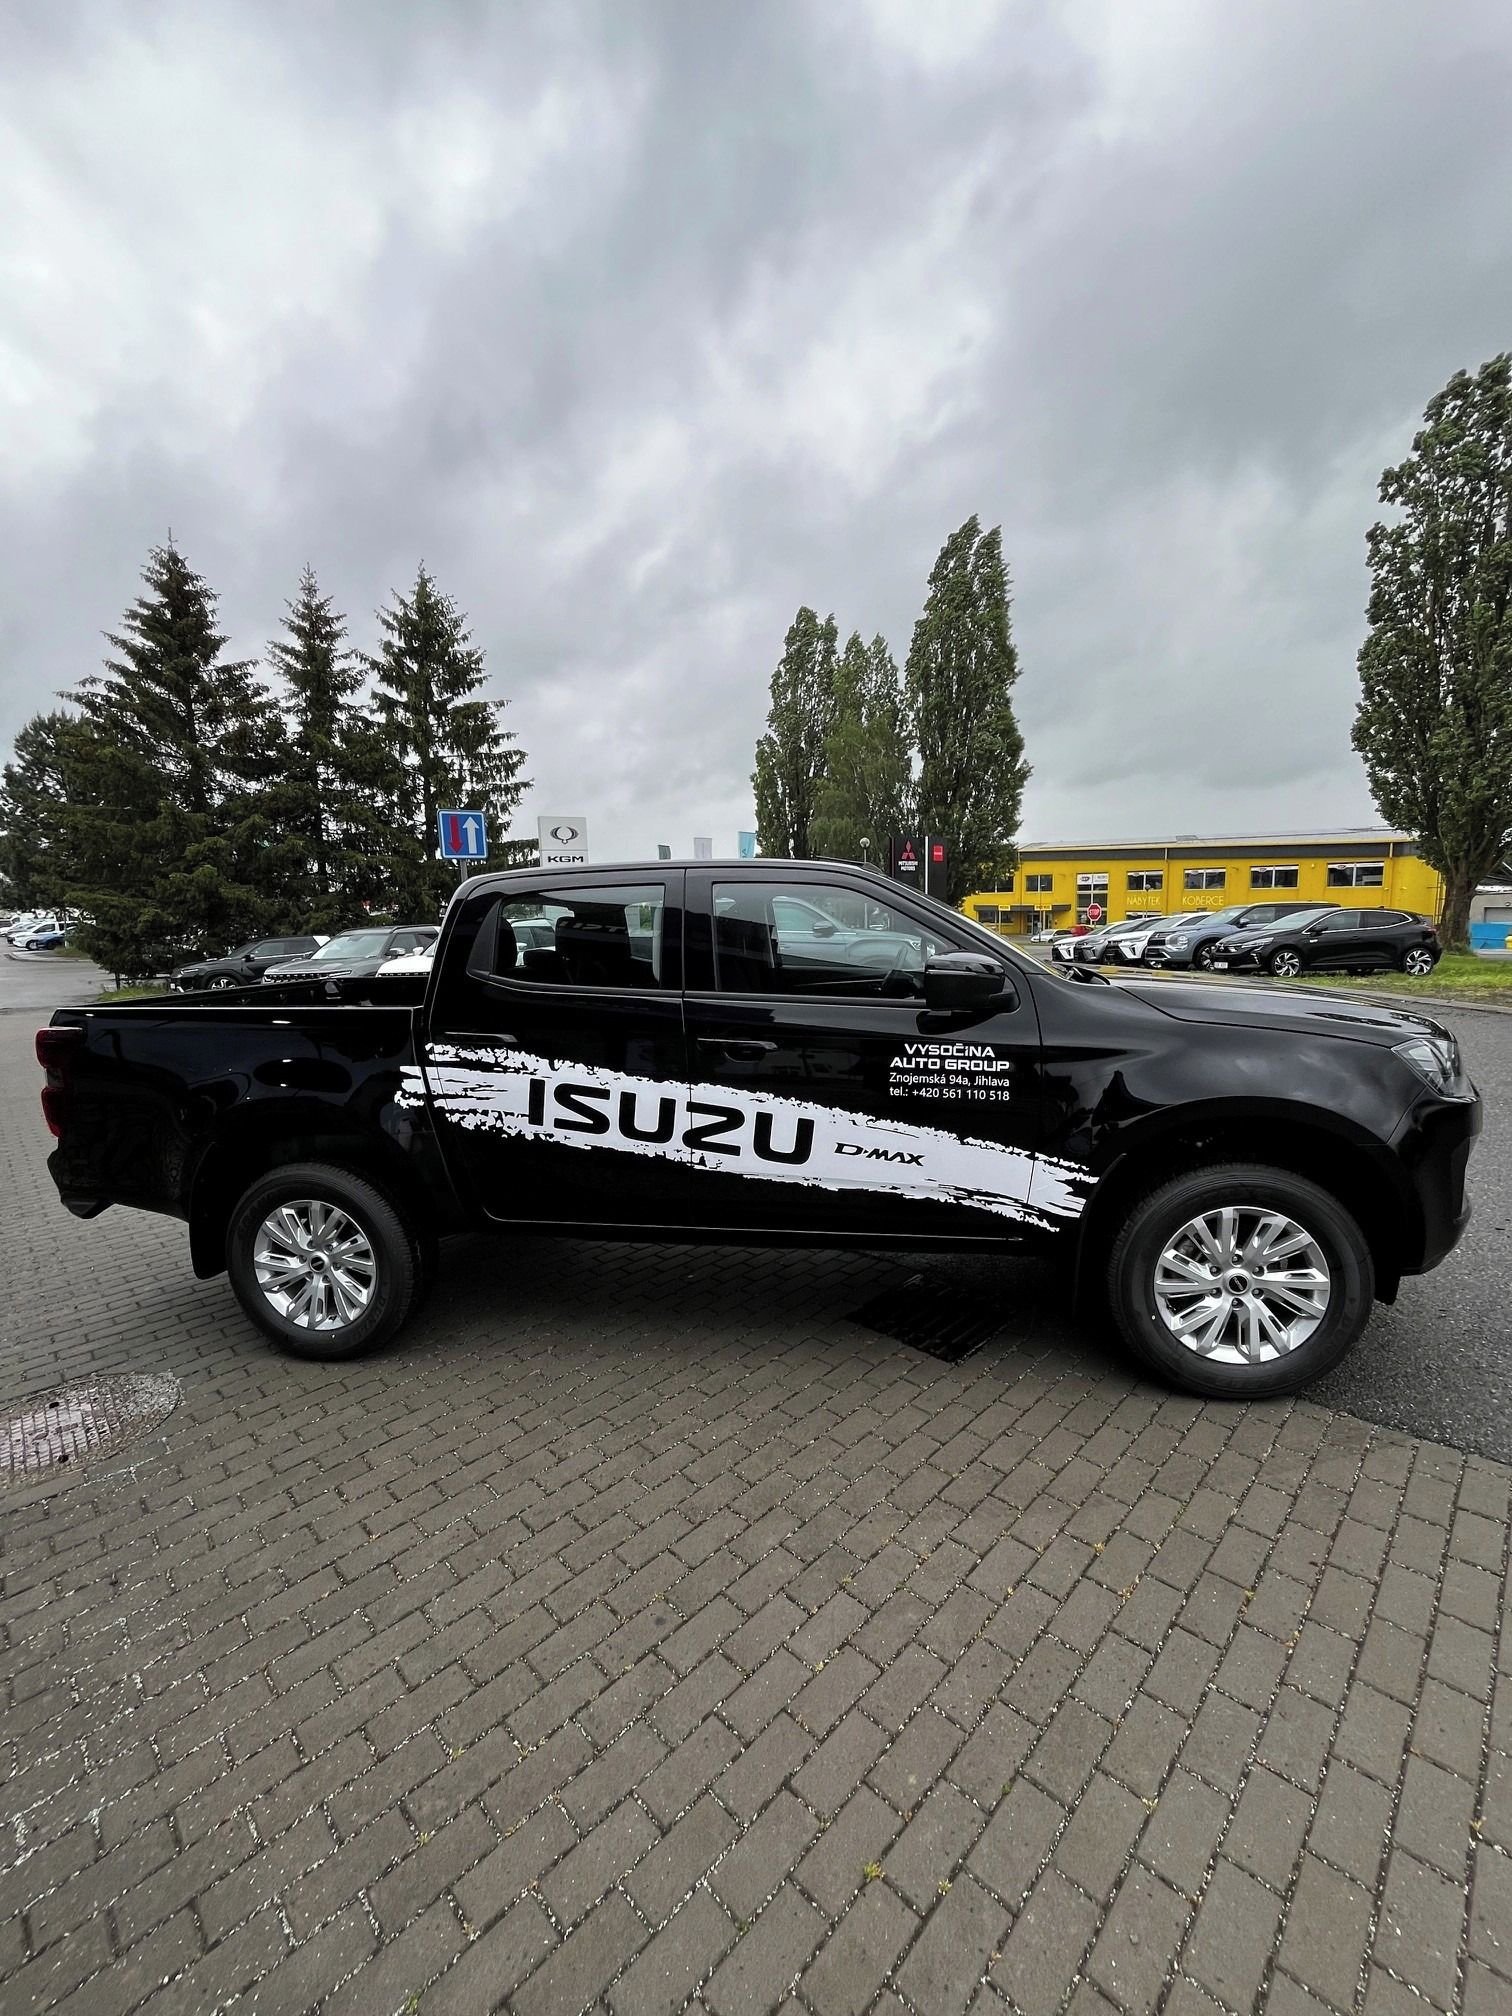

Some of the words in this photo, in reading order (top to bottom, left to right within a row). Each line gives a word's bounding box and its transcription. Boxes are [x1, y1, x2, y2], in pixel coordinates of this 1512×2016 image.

[1182, 895, 1225, 906] KOBERCE
[890, 1056, 941, 1069] AUTO
[944, 1059, 1010, 1072] GROUP
[889, 1072, 946, 1085] Znojemská
[949, 1074, 971, 1086] 94a,
[973, 1075, 1010, 1087] Jihlava
[889, 1086, 909, 1097] tel.:
[912, 1088, 939, 1098] +420
[942, 1088, 962, 1099] 561
[966, 1089, 986, 1100] 110
[989, 1090, 1010, 1101] 518
[527, 1077, 816, 1166] ISUZU
